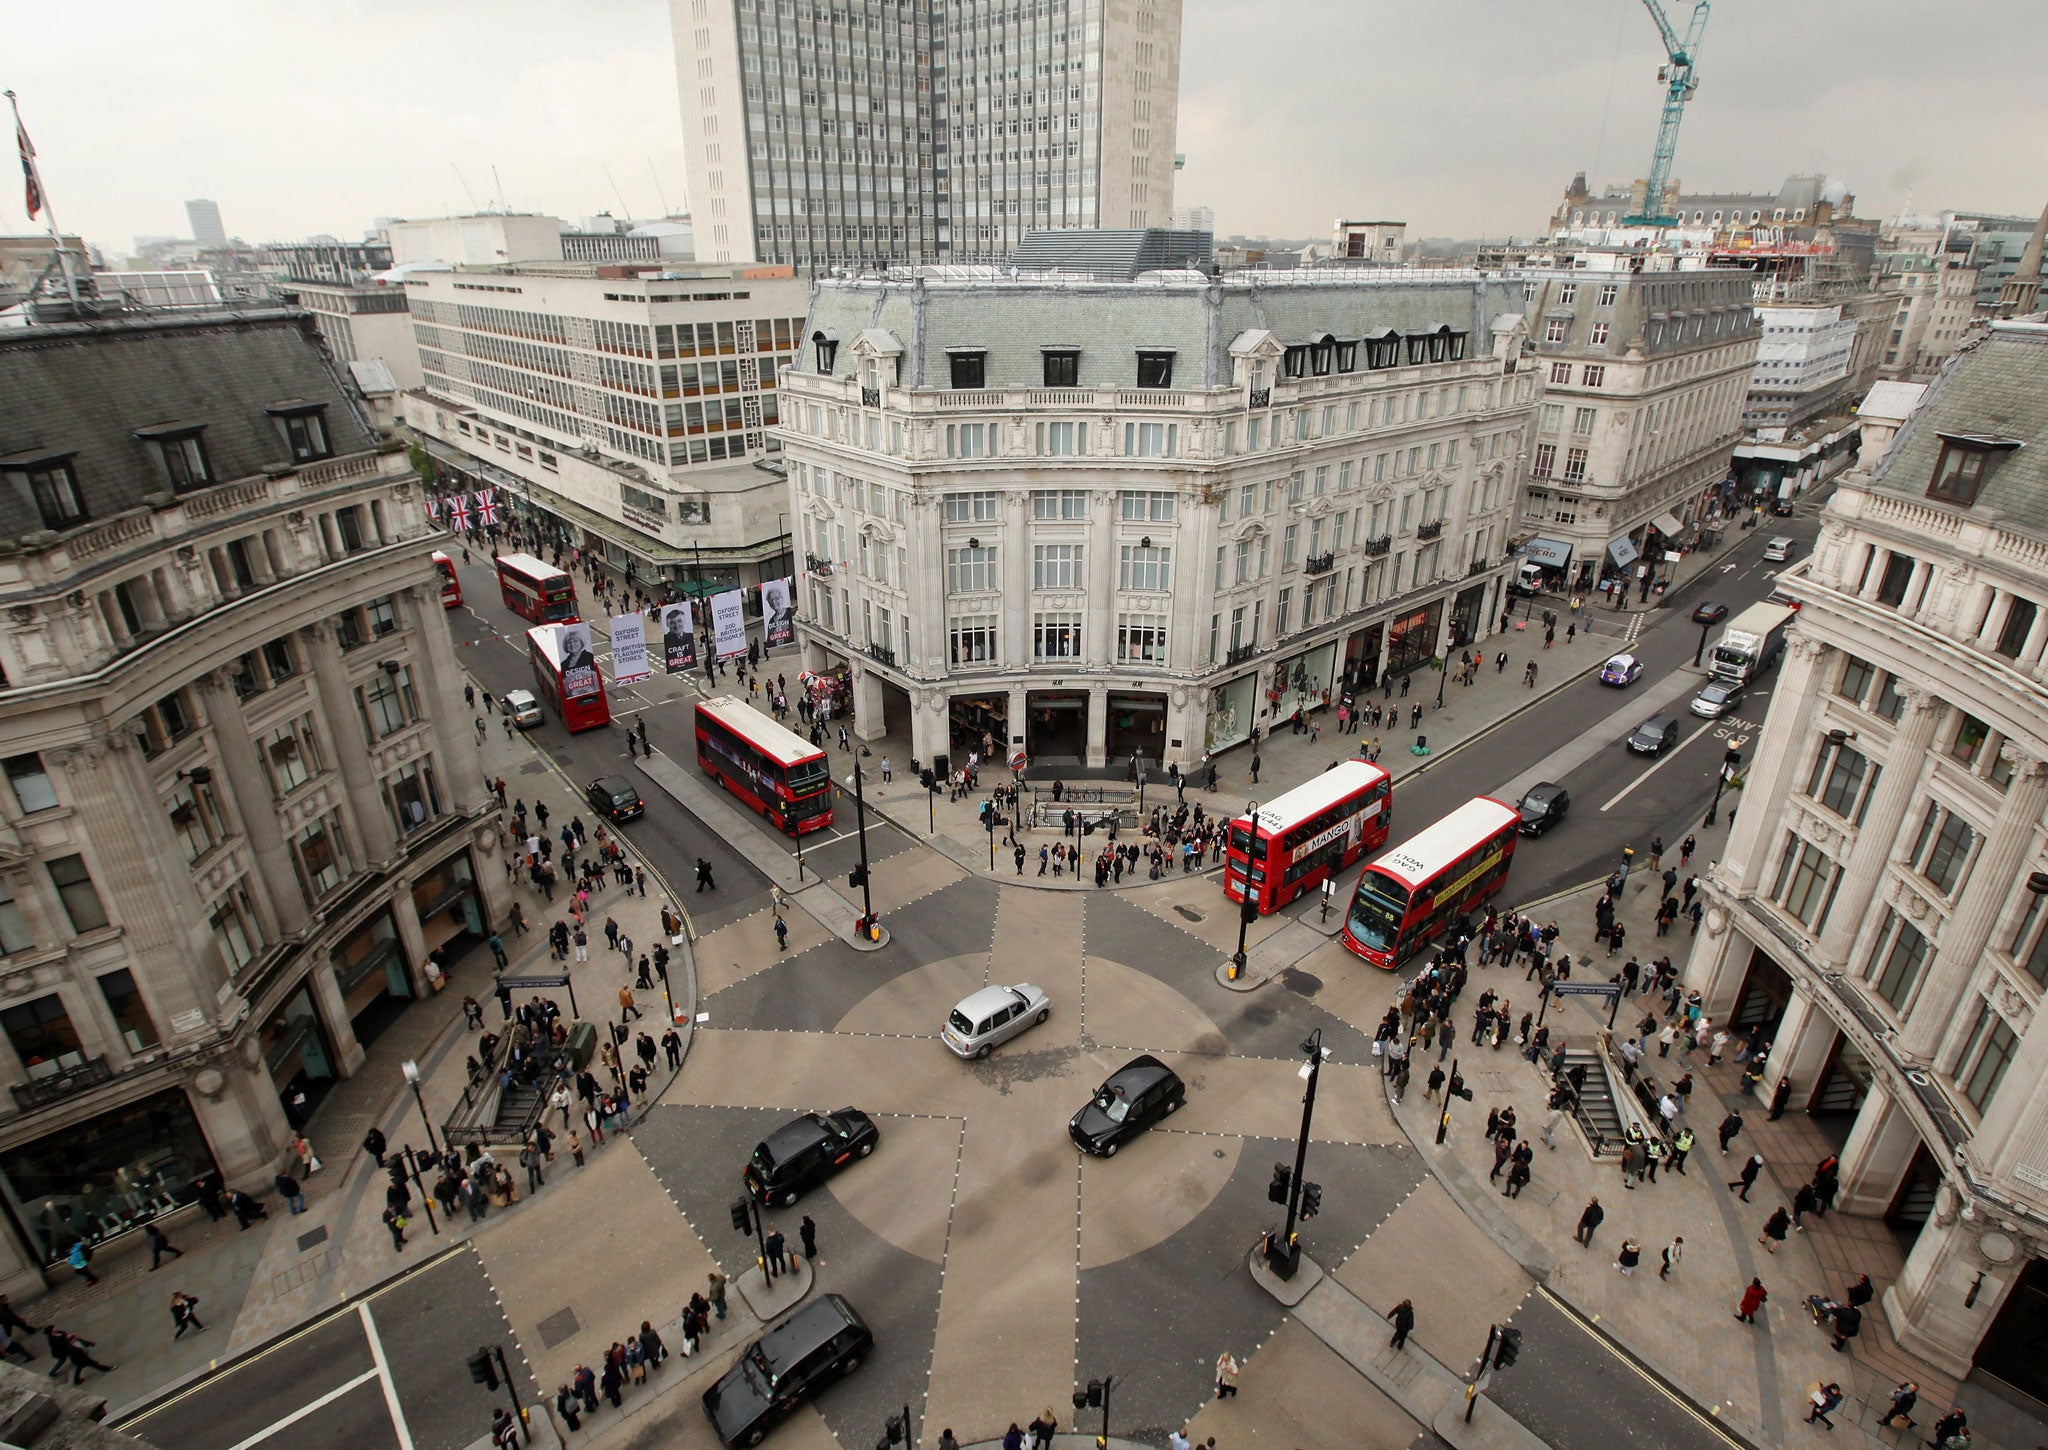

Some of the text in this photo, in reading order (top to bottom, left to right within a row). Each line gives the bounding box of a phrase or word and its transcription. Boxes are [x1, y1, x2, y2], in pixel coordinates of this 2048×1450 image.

[1529, 548, 1556, 558] NERO
[718, 606, 740, 614] OXFORD
[719, 612, 739, 620] STREET
[615, 627, 640, 636] OXFORD
[720, 628, 742, 636] BRITISH
[770, 630, 790, 640] GREAT
[616, 633, 639, 641] STREET
[716, 632, 744, 642] DESIGNERS
[621, 643, 645, 652] BRITISH
[668, 644, 690, 653] CRAFT
[614, 649, 644, 658] FLAGSHIP
[618, 655, 642, 664] STORES
[669, 656, 692, 666] GREAT
[565, 665, 591, 676] DESIGN
[568, 678, 592, 689] GREAT
[1262, 810, 1283, 821] GAG
[1312, 821, 1349, 850] MANGO
[1392, 859, 1416, 872] GAG
[1385, 912, 1394, 921] 88
